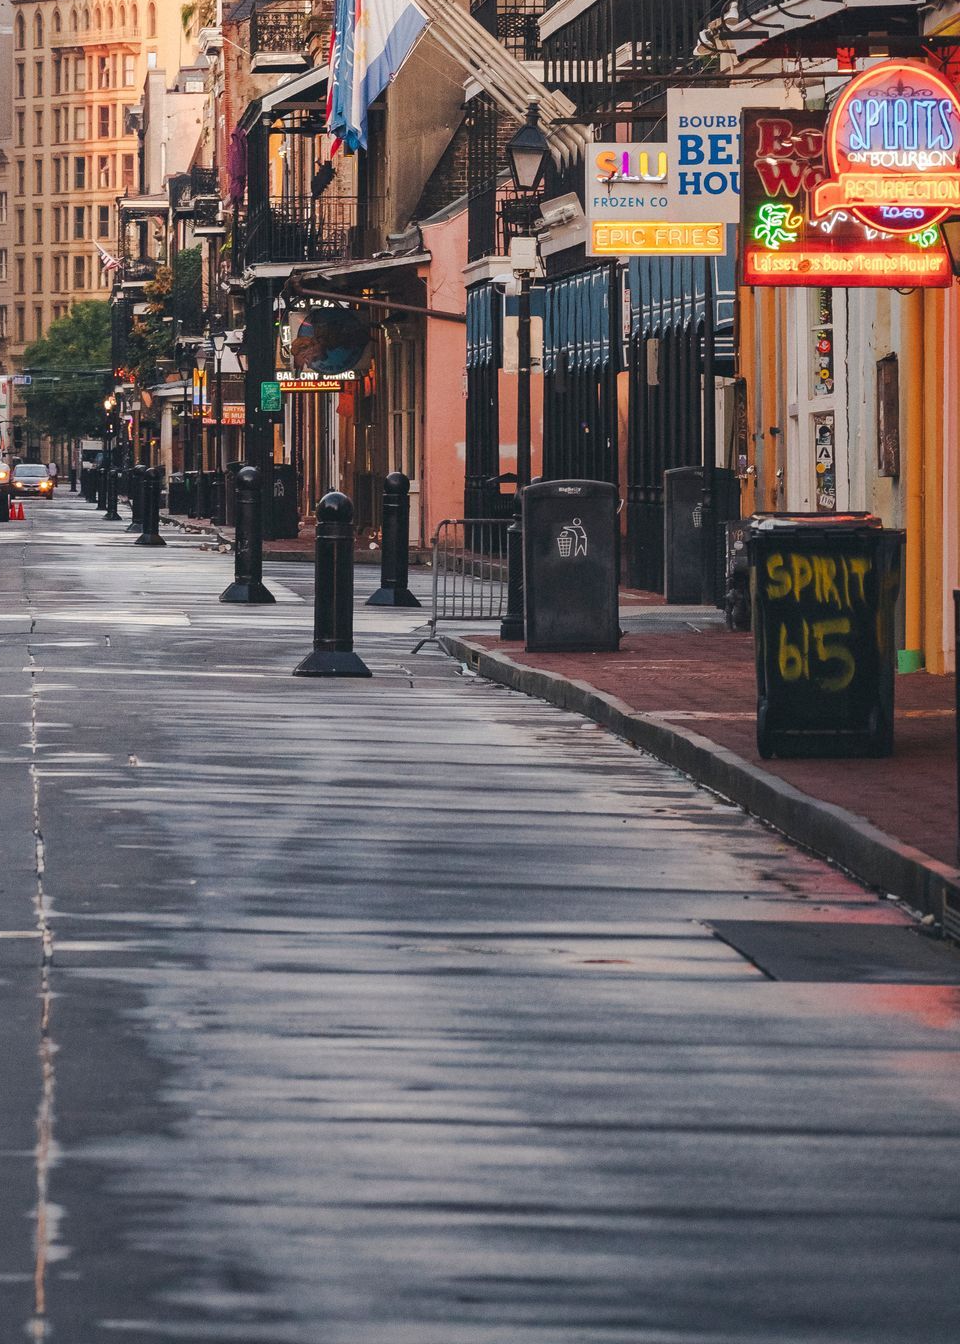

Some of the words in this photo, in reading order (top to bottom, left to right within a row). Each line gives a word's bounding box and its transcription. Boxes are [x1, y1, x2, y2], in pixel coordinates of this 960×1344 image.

[678, 116, 740, 128] BOURB
[847, 98, 955, 151] SPIRITS
[678, 134, 740, 166] BE
[869, 151, 956, 170] BOURBON
[844, 179, 960, 199] RESURRECTION
[593, 197, 645, 208] FROZEN
[595, 229, 646, 246] EPIC
[655, 229, 720, 246] FRIES
[753, 254, 798, 272] Laissez
[822, 254, 854, 271] Bons
[853, 254, 898, 273] Temps
[899, 254, 944, 273] Rouler
[276, 371, 318, 381] BALONY
[766, 553, 872, 611] SPIRIT
[778, 617, 856, 692] 615
